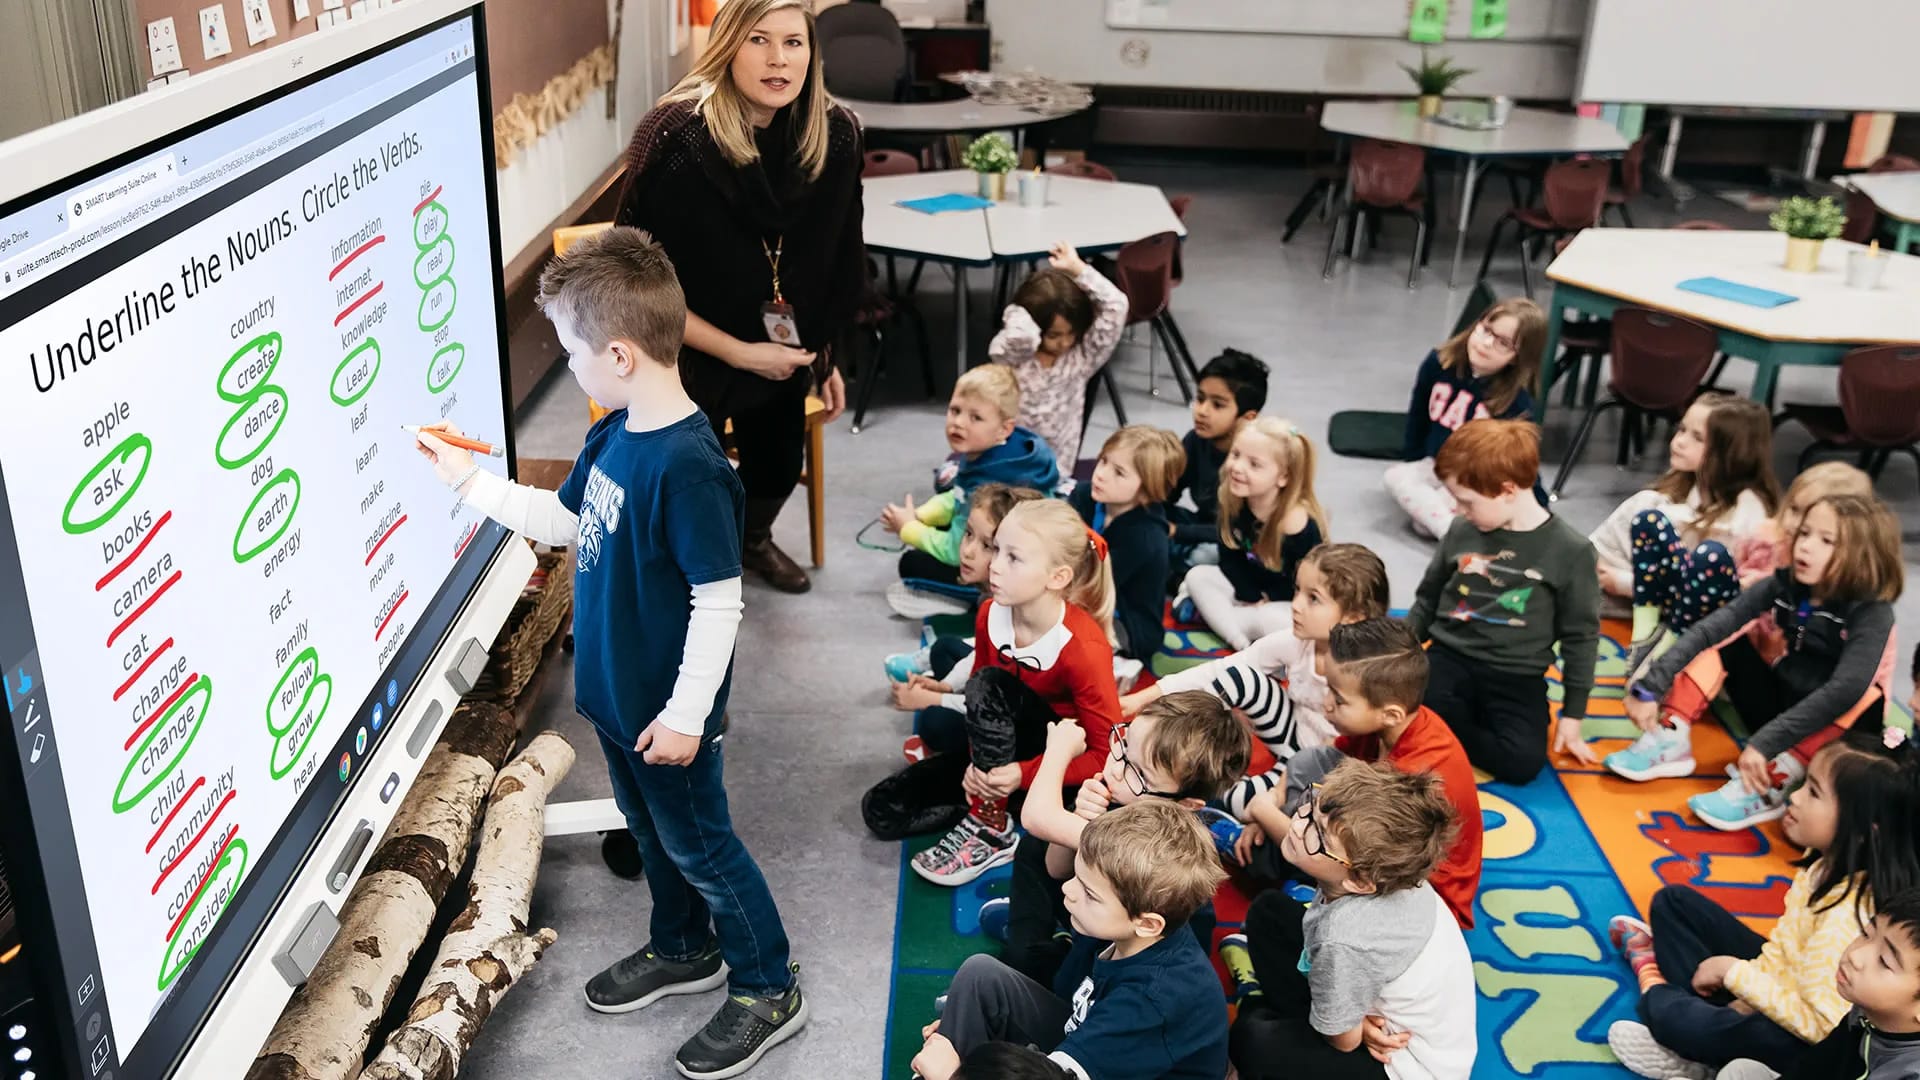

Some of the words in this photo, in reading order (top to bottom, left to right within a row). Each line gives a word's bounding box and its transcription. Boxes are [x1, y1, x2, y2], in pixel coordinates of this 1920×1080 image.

[85, 192, 105, 211] SMART
[105, 184, 128, 202] Learning
[128, 178, 141, 195] Suite
[140, 170, 157, 185] Online
[419, 180, 432, 203] pie
[11, 229, 29, 244] Drive
[332, 218, 381, 263] information
[423, 215, 439, 240] play
[30, 282, 175, 393] Underline
[181, 254, 222, 299] the
[227, 210, 297, 271] Nouns.
[303, 172, 349, 222] Circle
[353, 158, 378, 190] the
[380, 132, 422, 172] Verbs.
[427, 249, 443, 273] read
[337, 268, 372, 307] internet
[430, 292, 442, 310] run
[231, 296, 274, 339] country
[342, 302, 387, 350] knowledge
[434, 324, 449, 346] stop
[238, 349, 274, 389] create
[347, 360, 368, 392] Lead
[437, 361, 451, 384] talk
[83, 402, 129, 447] apple
[245, 399, 279, 438] dance
[351, 403, 367, 433] leaf
[440, 391, 458, 419] think
[1429, 382, 1491, 432] GA
[252, 456, 273, 486] dog
[356, 443, 377, 474] learn
[93, 468, 124, 505] ask
[361, 480, 384, 514] make
[258, 493, 287, 532] earth
[365, 502, 401, 553] medicine
[103, 510, 151, 564] books
[264, 528, 300, 578] energy
[452, 521, 471, 554] world
[114, 553, 172, 617] camera
[370, 553, 394, 592] movie
[269, 589, 292, 624] fact
[375, 580, 404, 628] octopus
[124, 634, 149, 671] cat
[276, 619, 308, 668] family
[379, 624, 404, 670] people
[133, 656, 186, 723] change
[282, 662, 312, 711] follow
[142, 706, 194, 775] change
[289, 710, 312, 757] grow
[294, 752, 316, 794] hear
[151, 769, 185, 824] child
[160, 766, 233, 873] community
[168, 823, 231, 920] computer
[177, 878, 231, 967] consider
